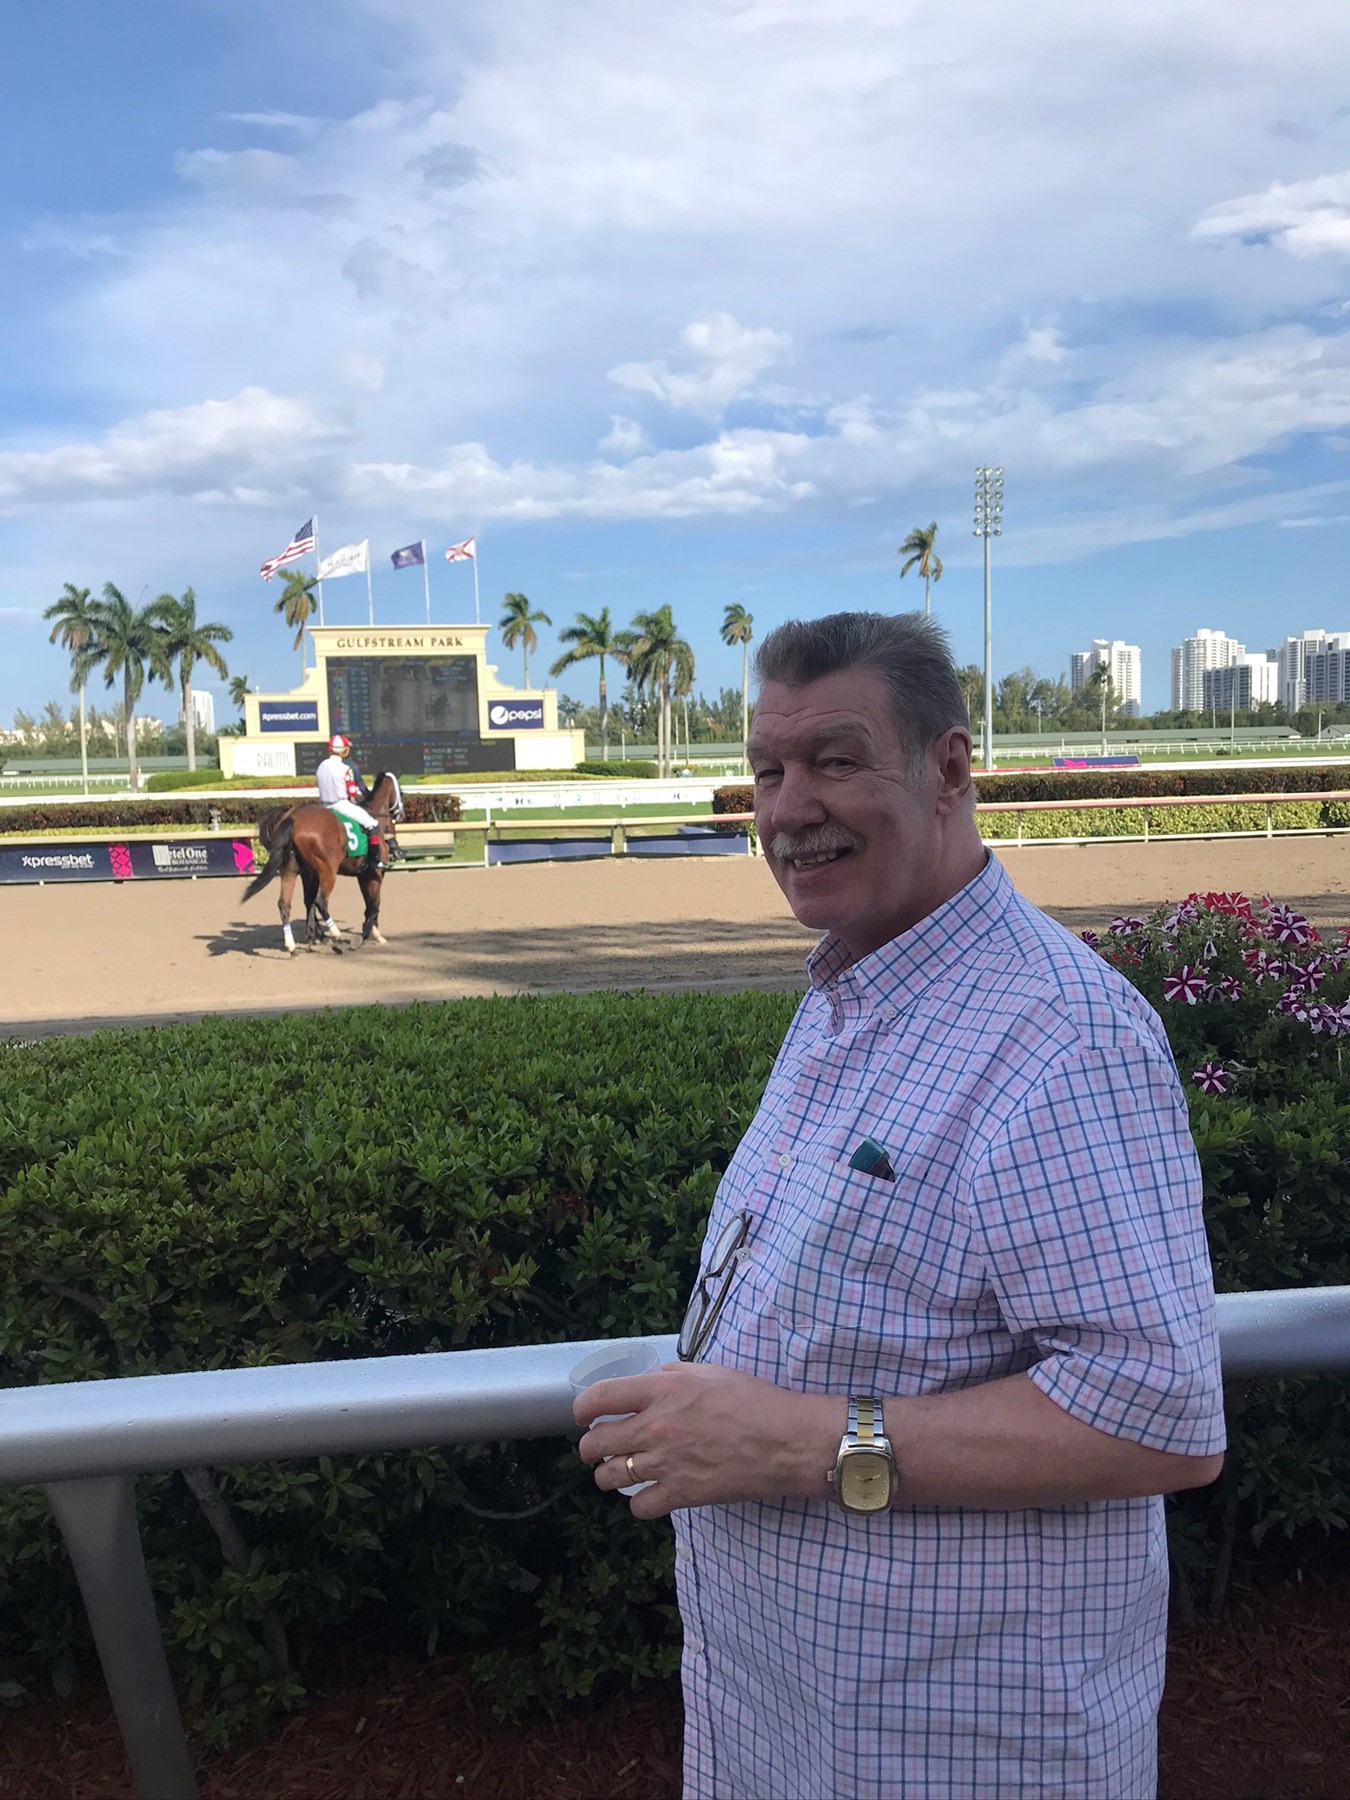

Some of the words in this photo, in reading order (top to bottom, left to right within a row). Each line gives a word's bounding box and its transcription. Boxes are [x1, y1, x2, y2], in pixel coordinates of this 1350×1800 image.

[336, 637, 424, 648] GULFSTREAM
[430, 636, 463, 647] PARK
[262, 712, 317, 721] xpressbet.com
[509, 708, 542, 721] pepsi
[343, 821, 359, 851] 5
[186, 847, 208, 859] One
[21, 853, 92, 869] xpressbet
